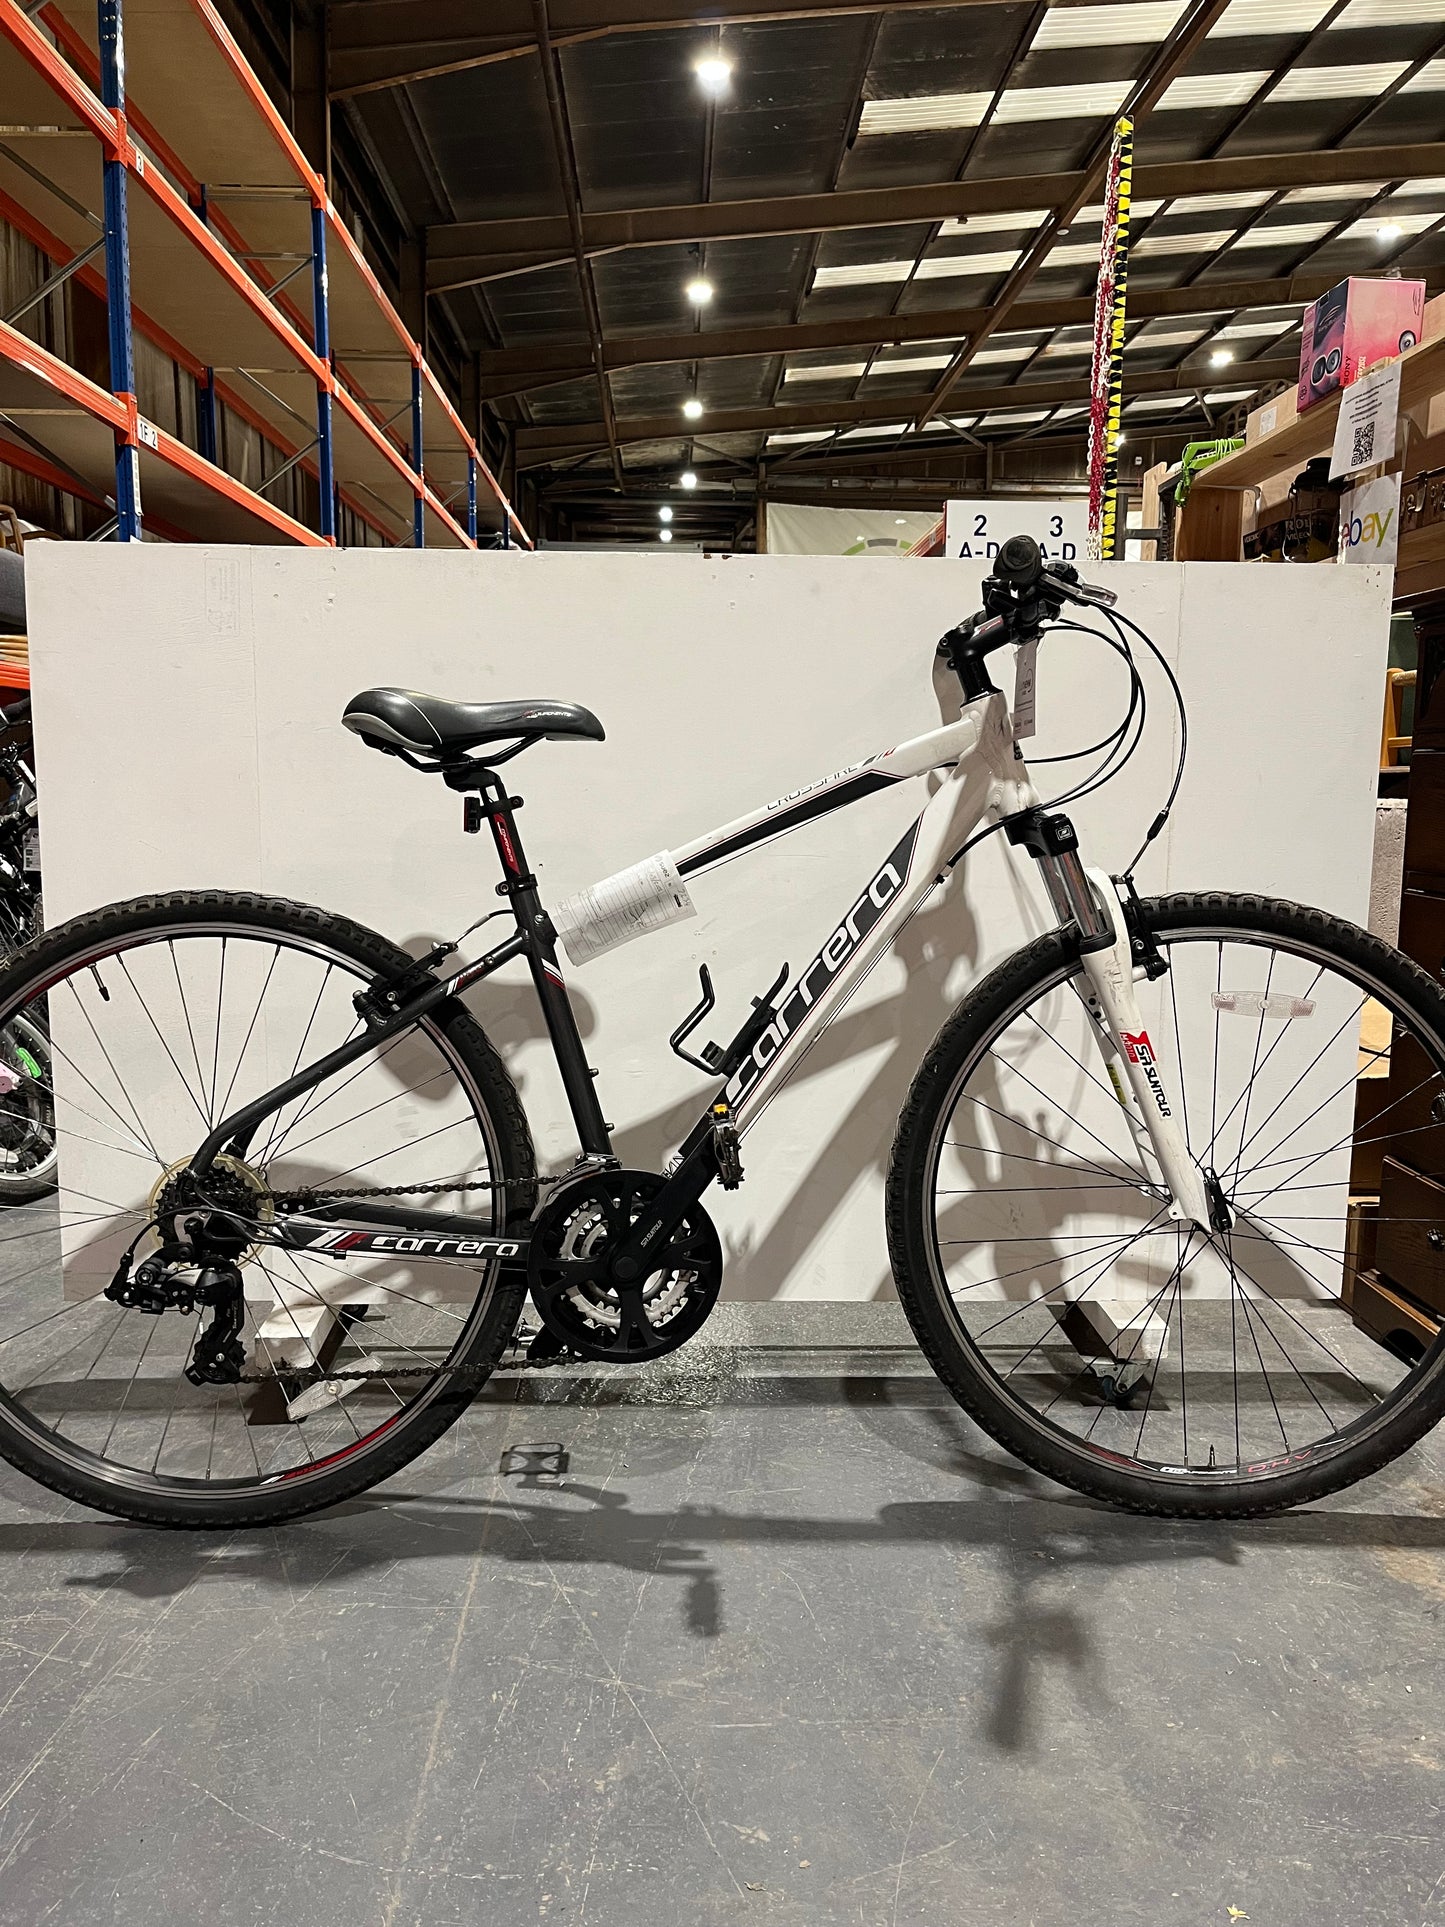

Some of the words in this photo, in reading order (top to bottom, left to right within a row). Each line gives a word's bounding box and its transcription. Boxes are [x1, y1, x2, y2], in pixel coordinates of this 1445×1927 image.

[152, 431, 157, 447] 2
[974, 514, 987, 536] 2
[1049, 515, 1063, 537] 3
[1341, 508, 1394, 549] ebay
[959, 542, 999, 559] A-D
[1040, 543, 1076, 561] A-D
[726, 863, 902, 1107] carrera
[1136, 1045, 1152, 1066] SR
[1144, 1067, 1172, 1117] SUNTOUR
[646, 1219, 663, 1240] SUNTOUR
[371, 1236, 519, 1256] carrera
